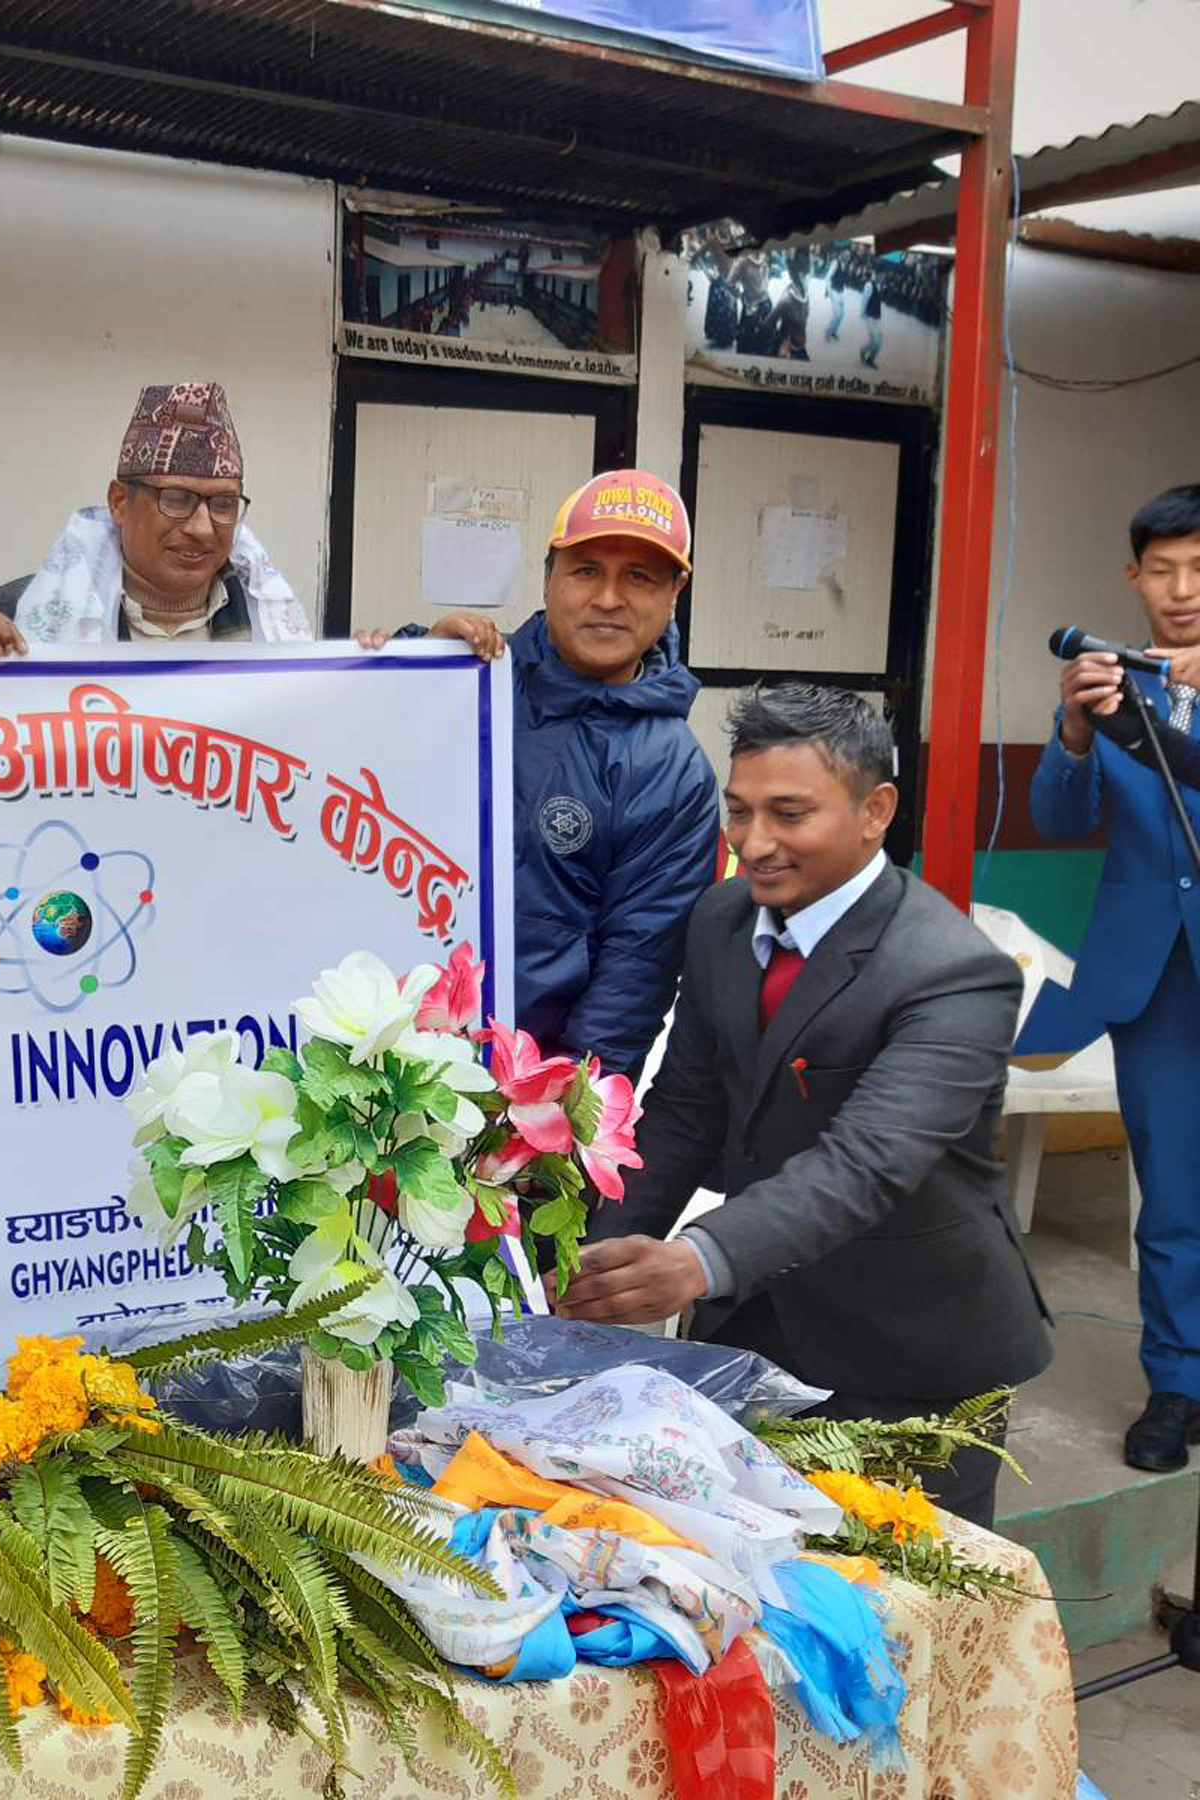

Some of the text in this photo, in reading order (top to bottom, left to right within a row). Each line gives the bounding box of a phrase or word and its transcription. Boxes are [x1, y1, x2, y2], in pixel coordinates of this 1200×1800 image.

[344, 328, 363, 349] We
[367, 336, 388, 352] are
[392, 336, 439, 361] today's
[486, 350, 510, 366] and
[592, 503, 672, 530] CYCLONES
[594, 487, 672, 520] IOWA STATE
[319, 766, 471, 942] केन्द्र
[11, 1013, 298, 1106] INNOVON
[11, 1243, 203, 1298] GHYANGPHED
